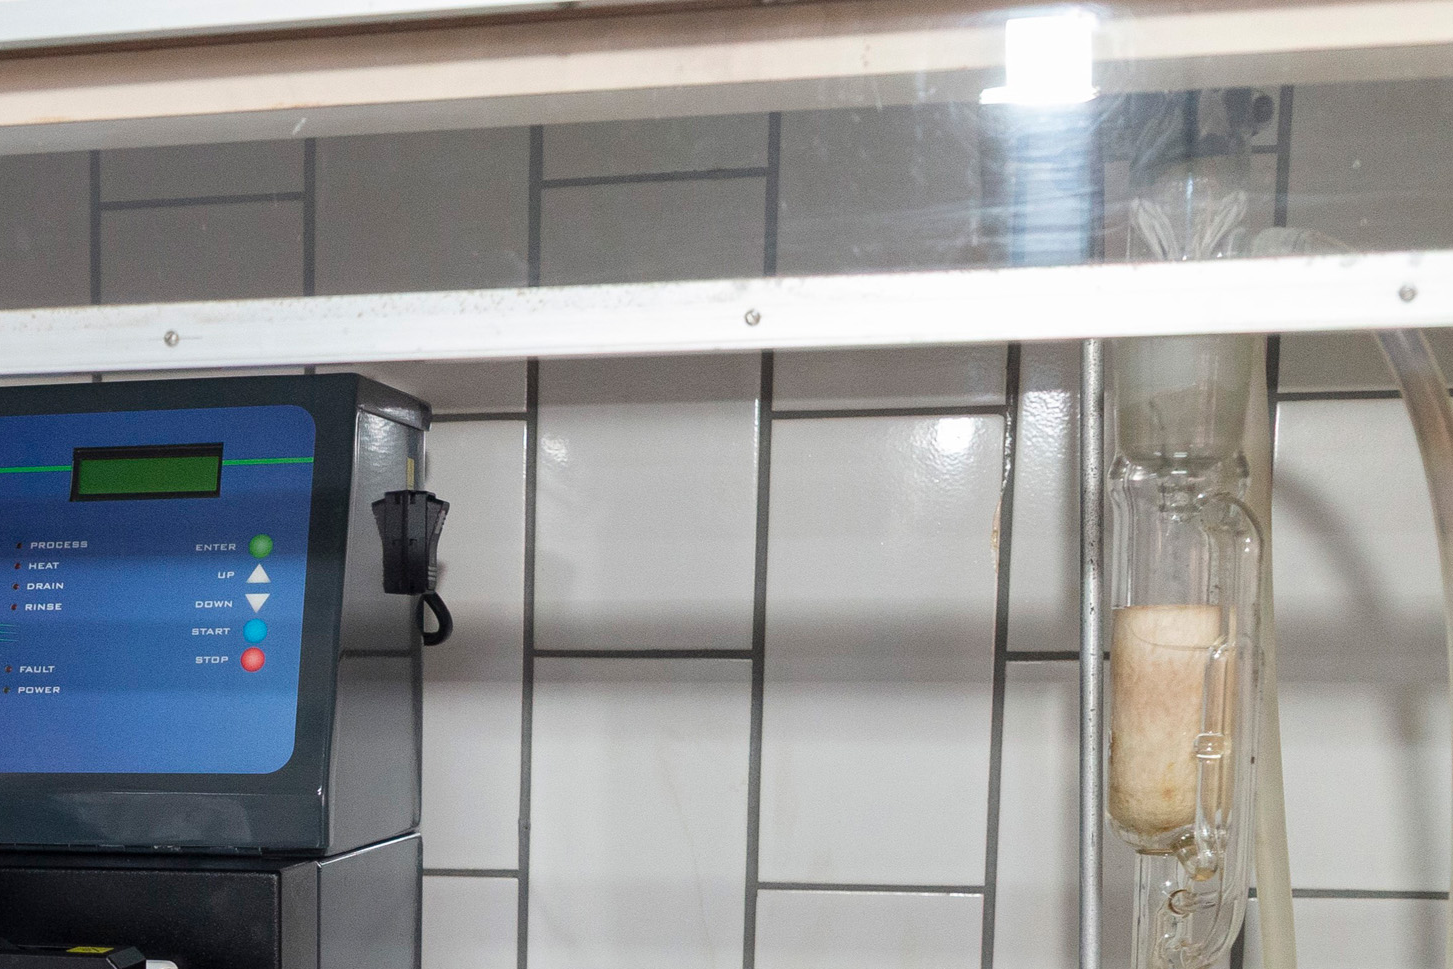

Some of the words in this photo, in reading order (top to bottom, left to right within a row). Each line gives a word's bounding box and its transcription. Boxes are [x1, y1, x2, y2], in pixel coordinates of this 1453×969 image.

[30, 540, 89, 550] PROCESS
[195, 543, 236, 551] ENTER
[28, 561, 60, 570] HEAT
[217, 571, 235, 579] UP
[26, 582, 64, 590] DRAIN
[24, 603, 63, 611] RINSE
[195, 600, 233, 608] DOWN
[191, 627, 231, 636] START
[195, 656, 229, 664] STOP
[19, 665, 56, 674] FAULT
[17, 686, 61, 694] POWER
